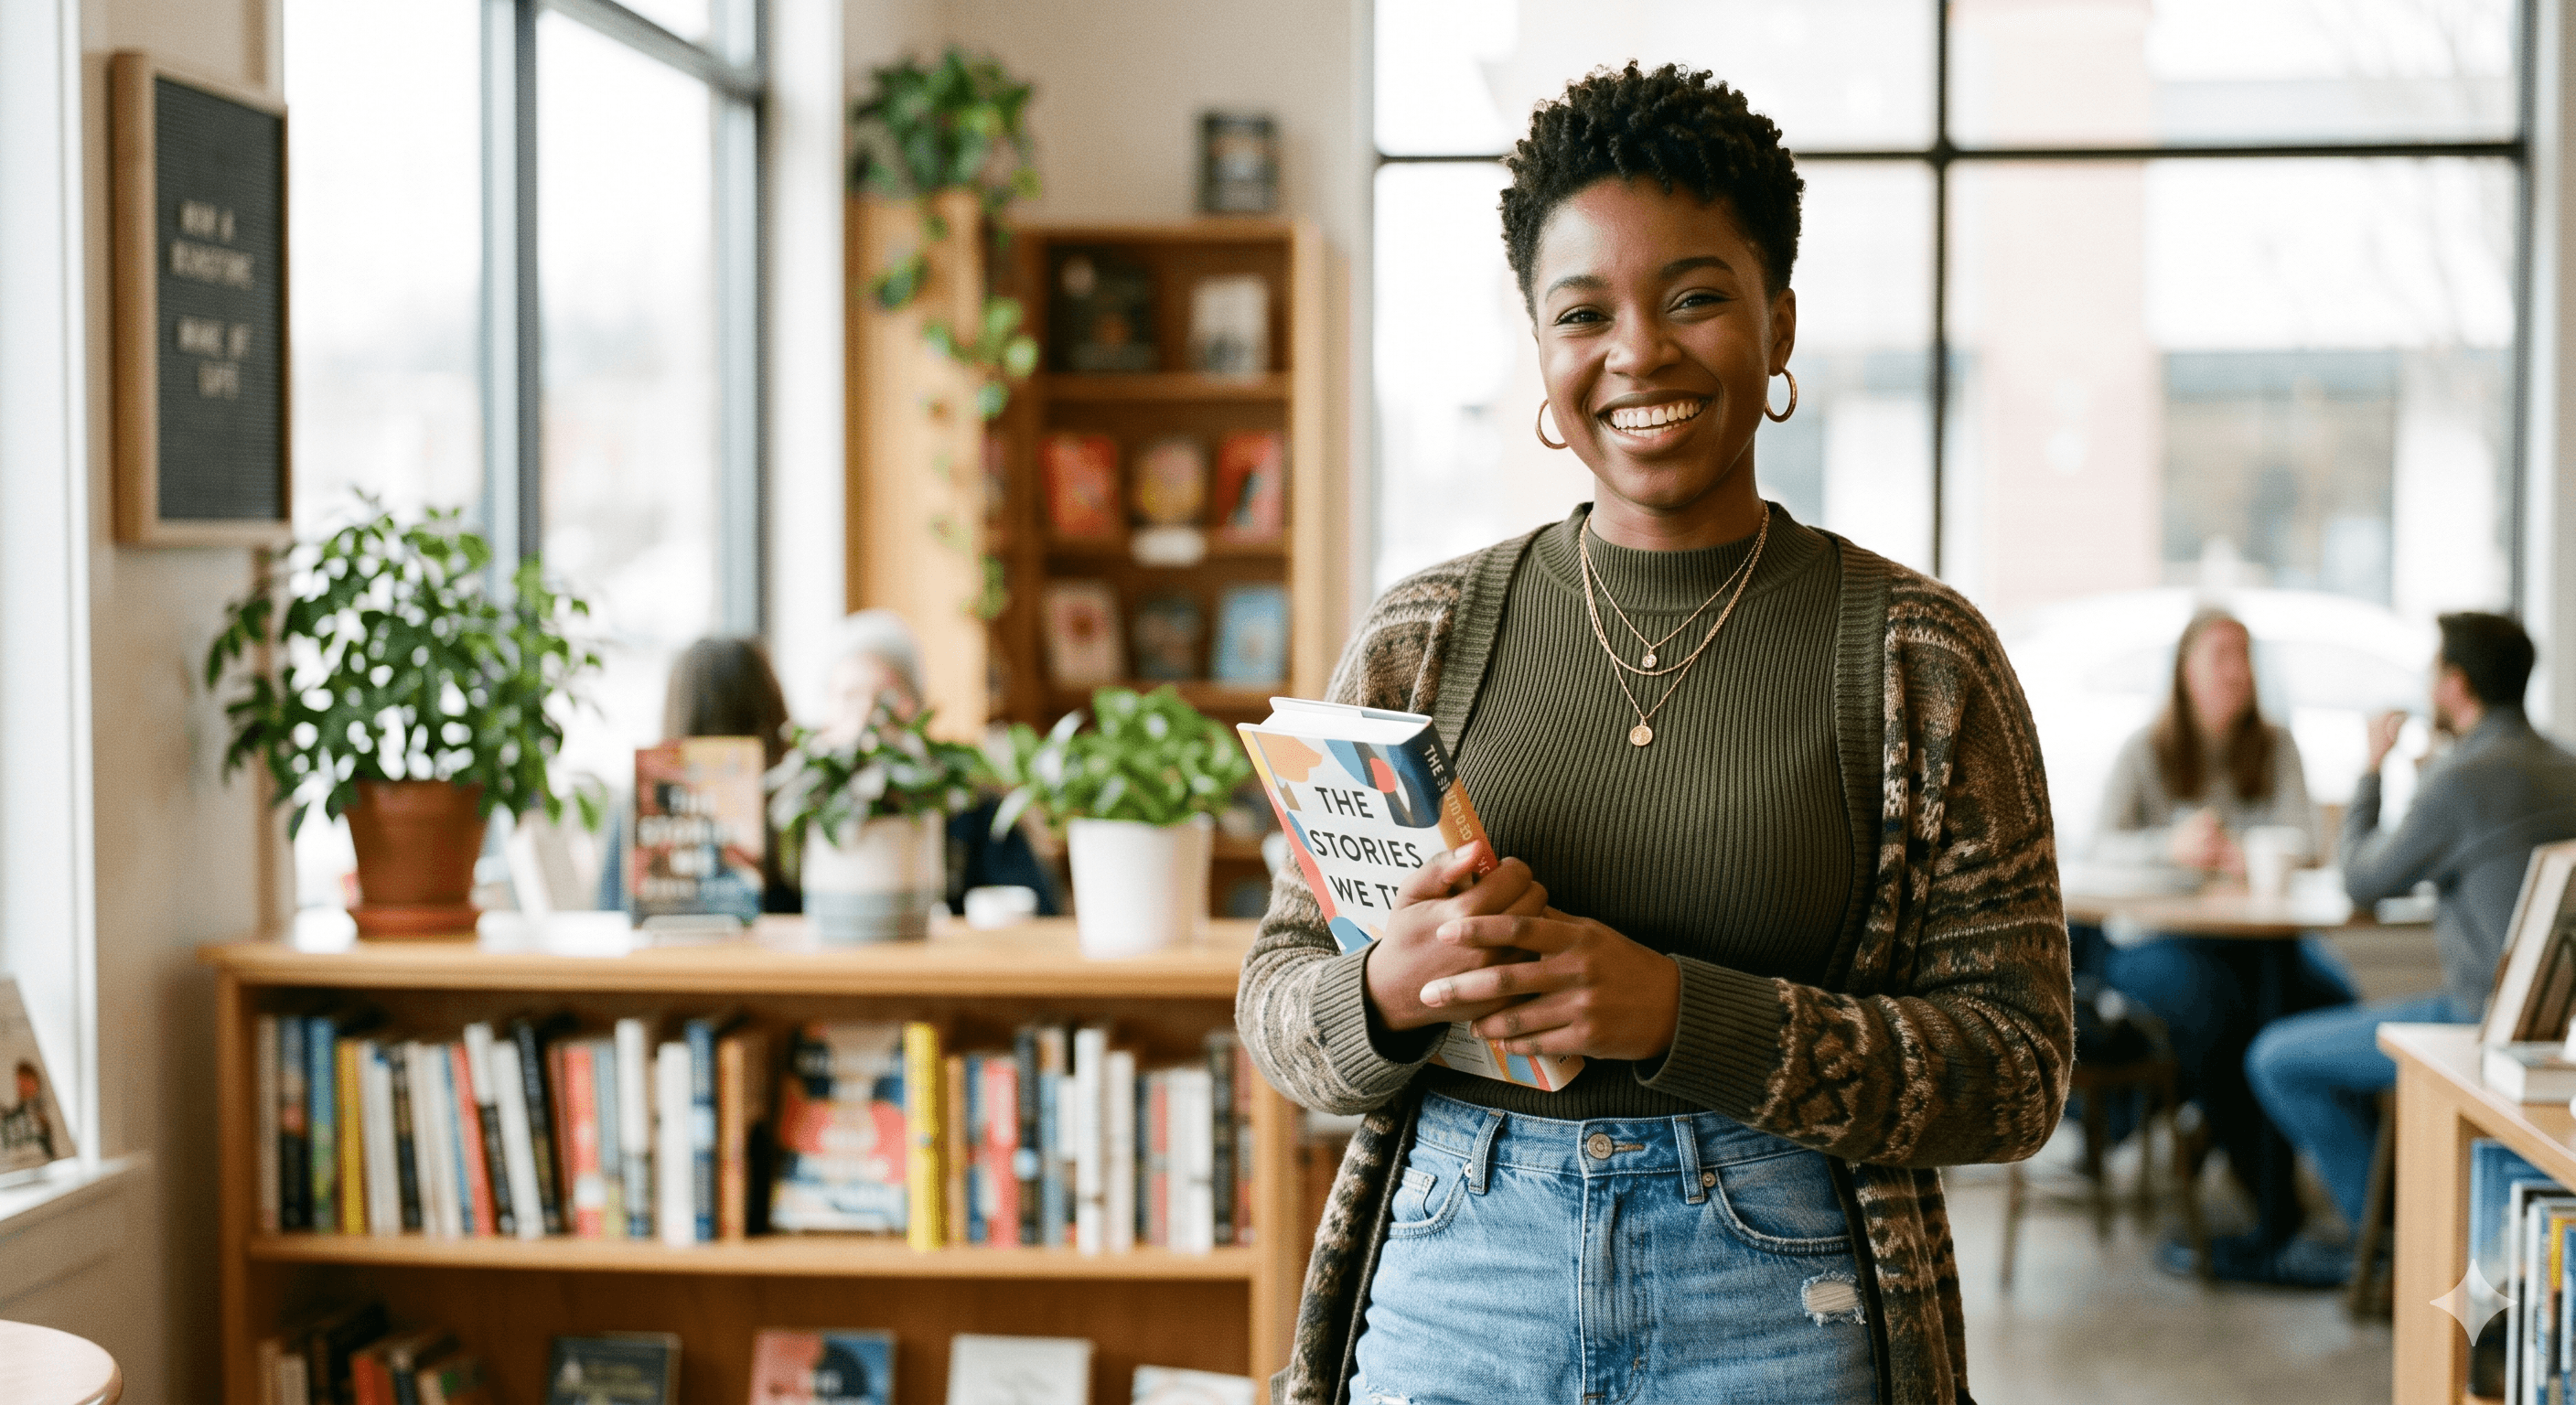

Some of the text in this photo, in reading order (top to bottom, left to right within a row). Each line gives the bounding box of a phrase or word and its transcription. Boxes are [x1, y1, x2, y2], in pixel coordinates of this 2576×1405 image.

[1424, 744, 1444, 777] THE
[1315, 787, 1374, 819] THE
[1309, 830, 1423, 869] STORIES
[1328, 875, 1399, 910] WE T
